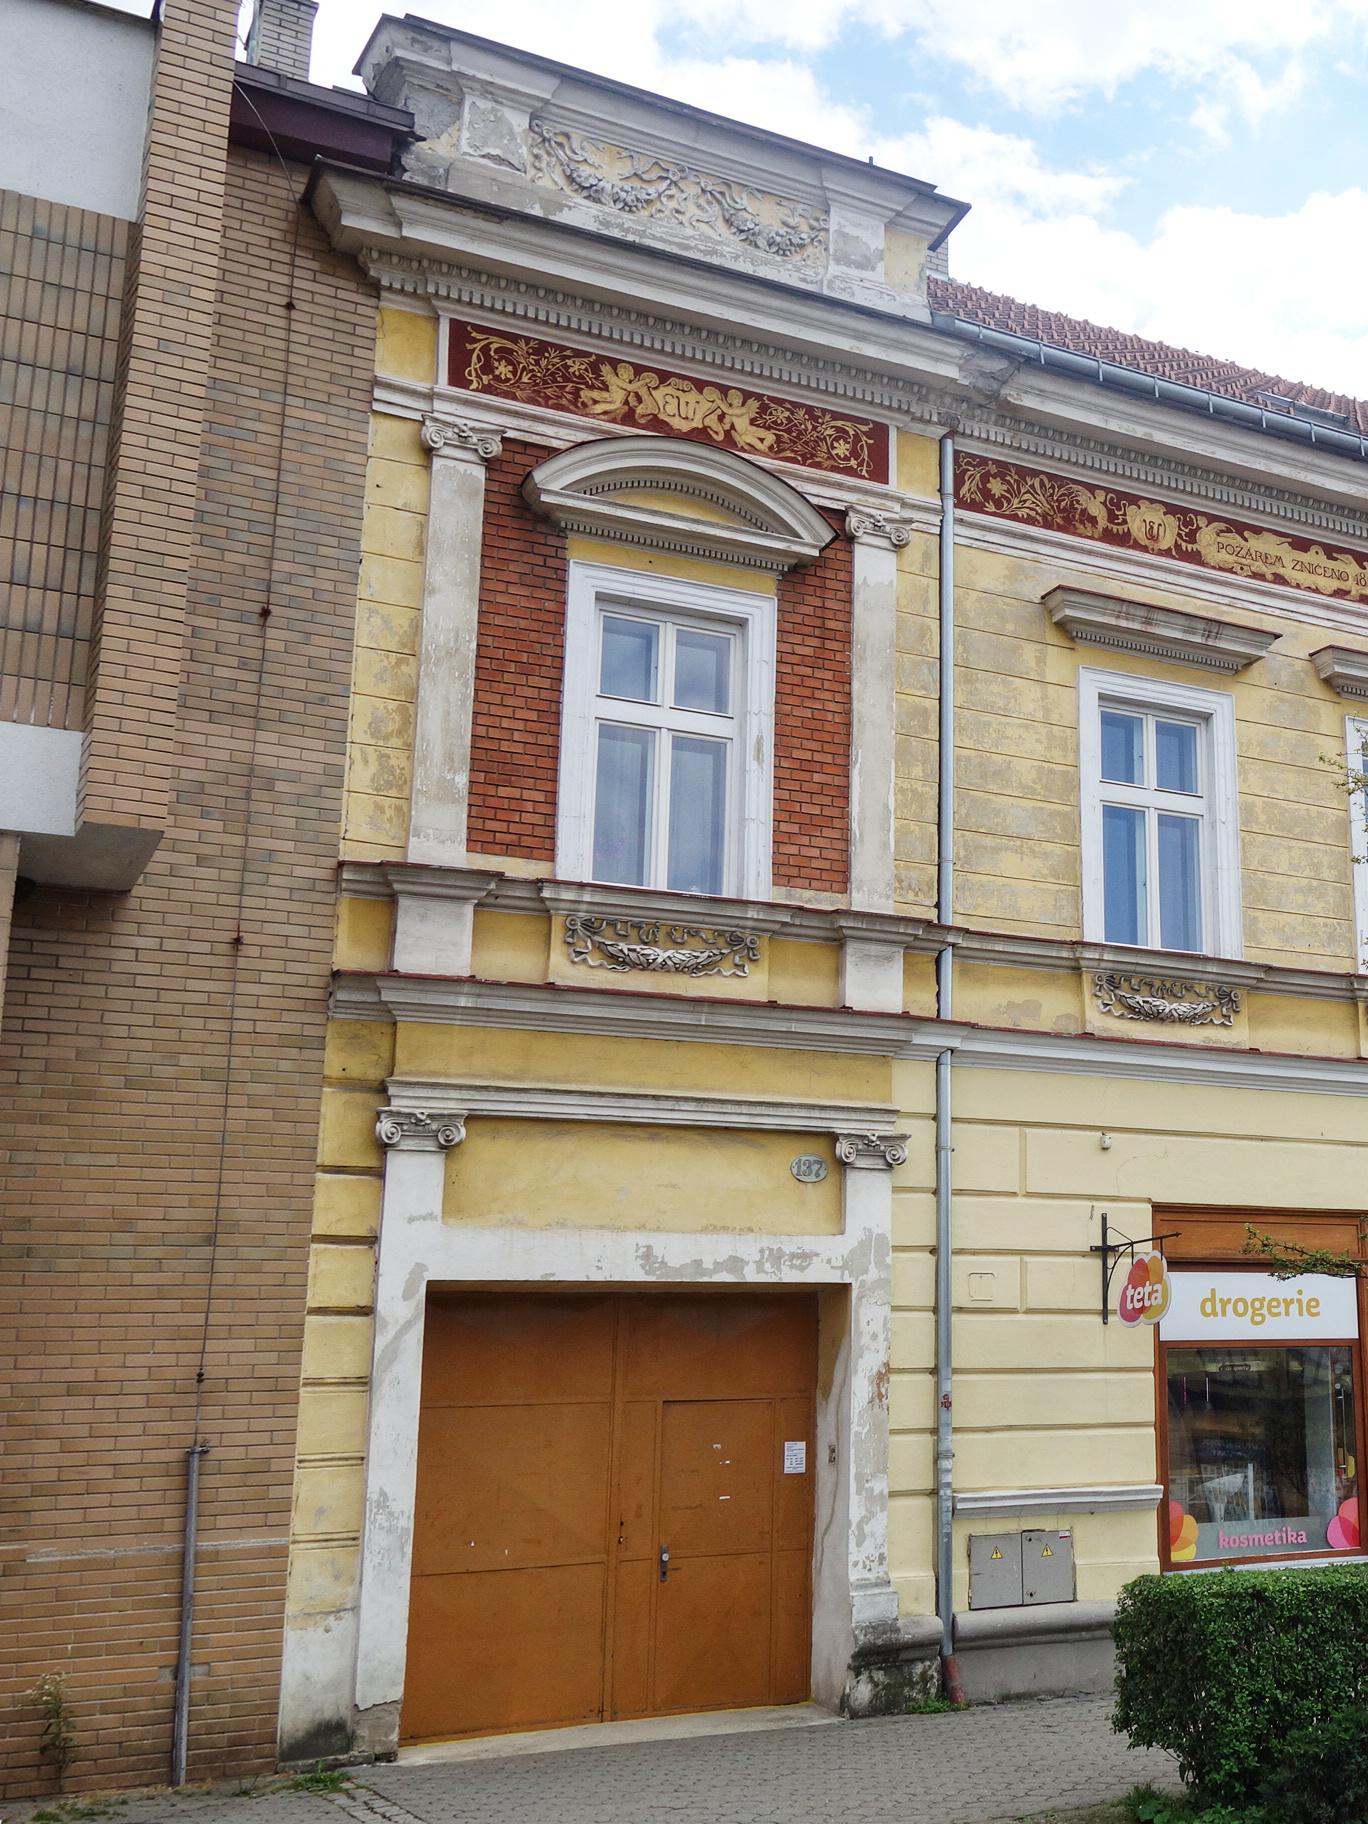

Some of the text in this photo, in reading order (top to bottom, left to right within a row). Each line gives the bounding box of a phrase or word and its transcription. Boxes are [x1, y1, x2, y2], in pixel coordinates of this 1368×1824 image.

[794, 1158, 824, 1179] 137
[1126, 1280, 1163, 1310] teta
[1199, 1287, 1321, 1326] drogerie
[1218, 1526, 1308, 1550] kosmetika
